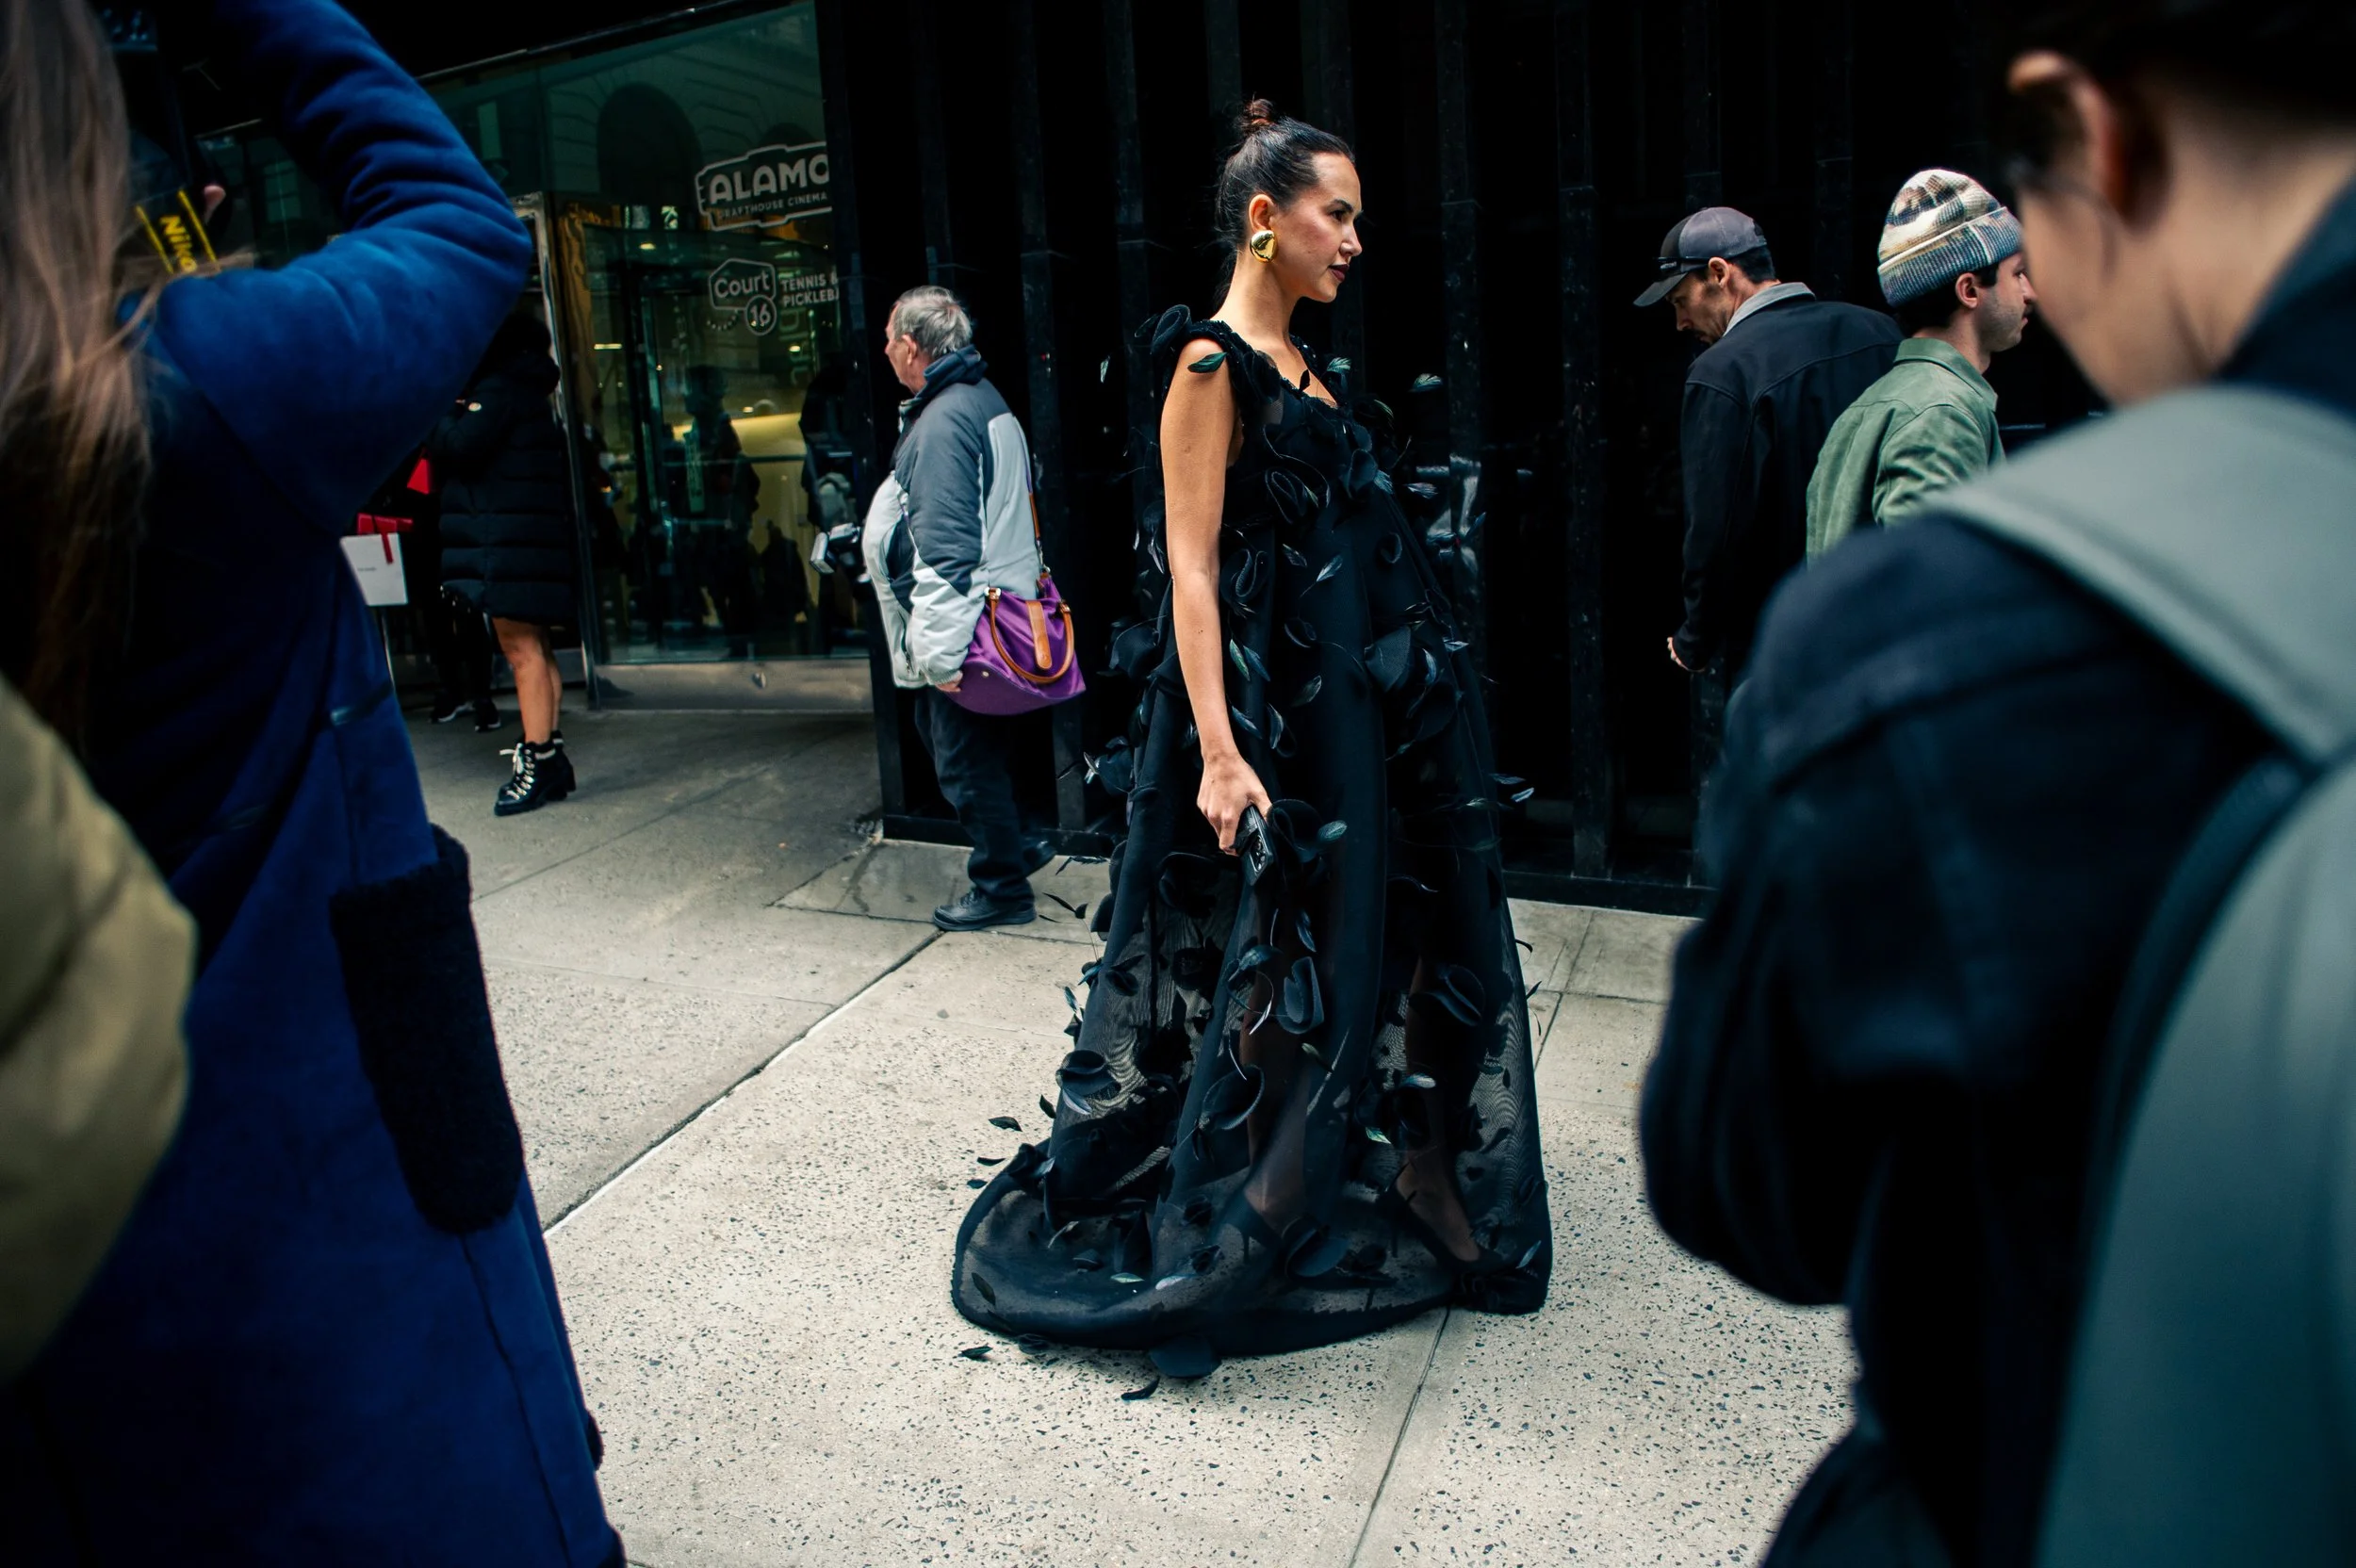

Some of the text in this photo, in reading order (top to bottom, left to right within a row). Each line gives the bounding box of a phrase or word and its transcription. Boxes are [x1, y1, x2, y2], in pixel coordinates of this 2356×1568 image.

[710, 154, 829, 204] ALAMO
[787, 191, 828, 206] CINEMA
[713, 270, 770, 299] Court
[780, 273, 826, 293] TENNIS
[750, 303, 771, 325] 16
